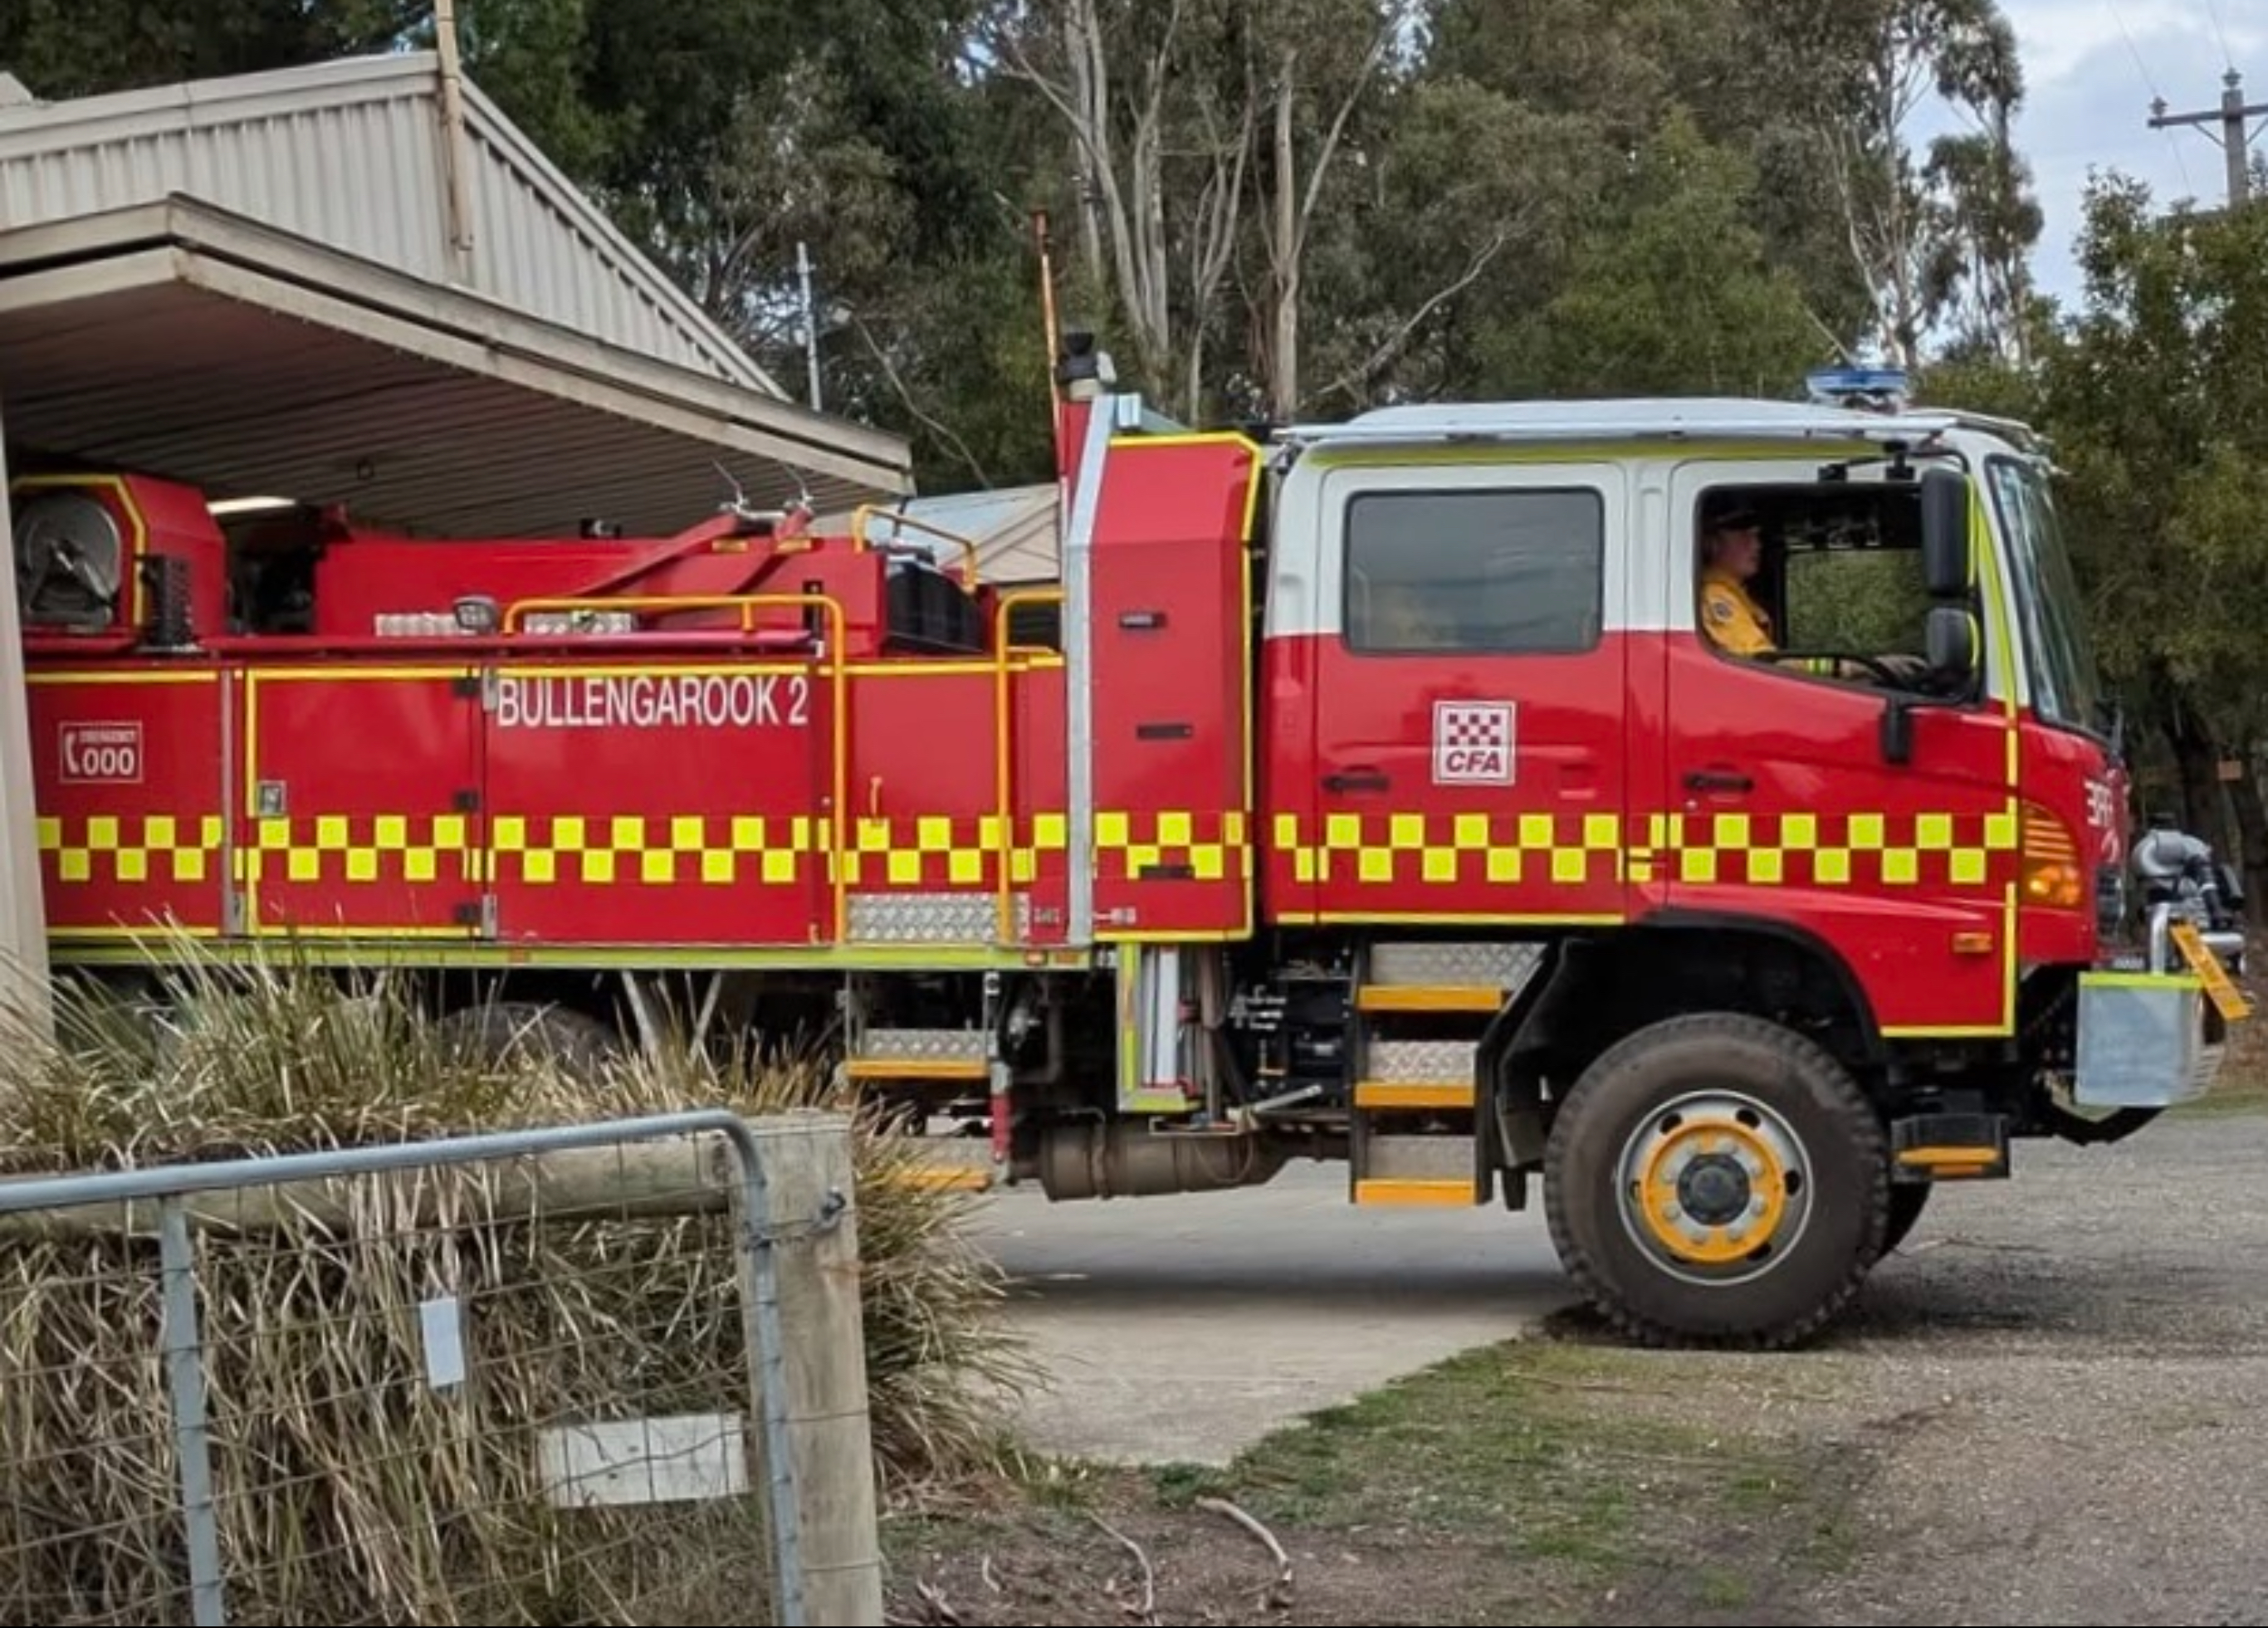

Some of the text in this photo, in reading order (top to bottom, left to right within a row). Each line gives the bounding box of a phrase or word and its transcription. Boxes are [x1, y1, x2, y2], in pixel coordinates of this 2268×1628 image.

[498, 674, 809, 727] BULLENGAROOK 2
[84, 747, 134, 775] 000
[1445, 750, 1502, 773] CFA
